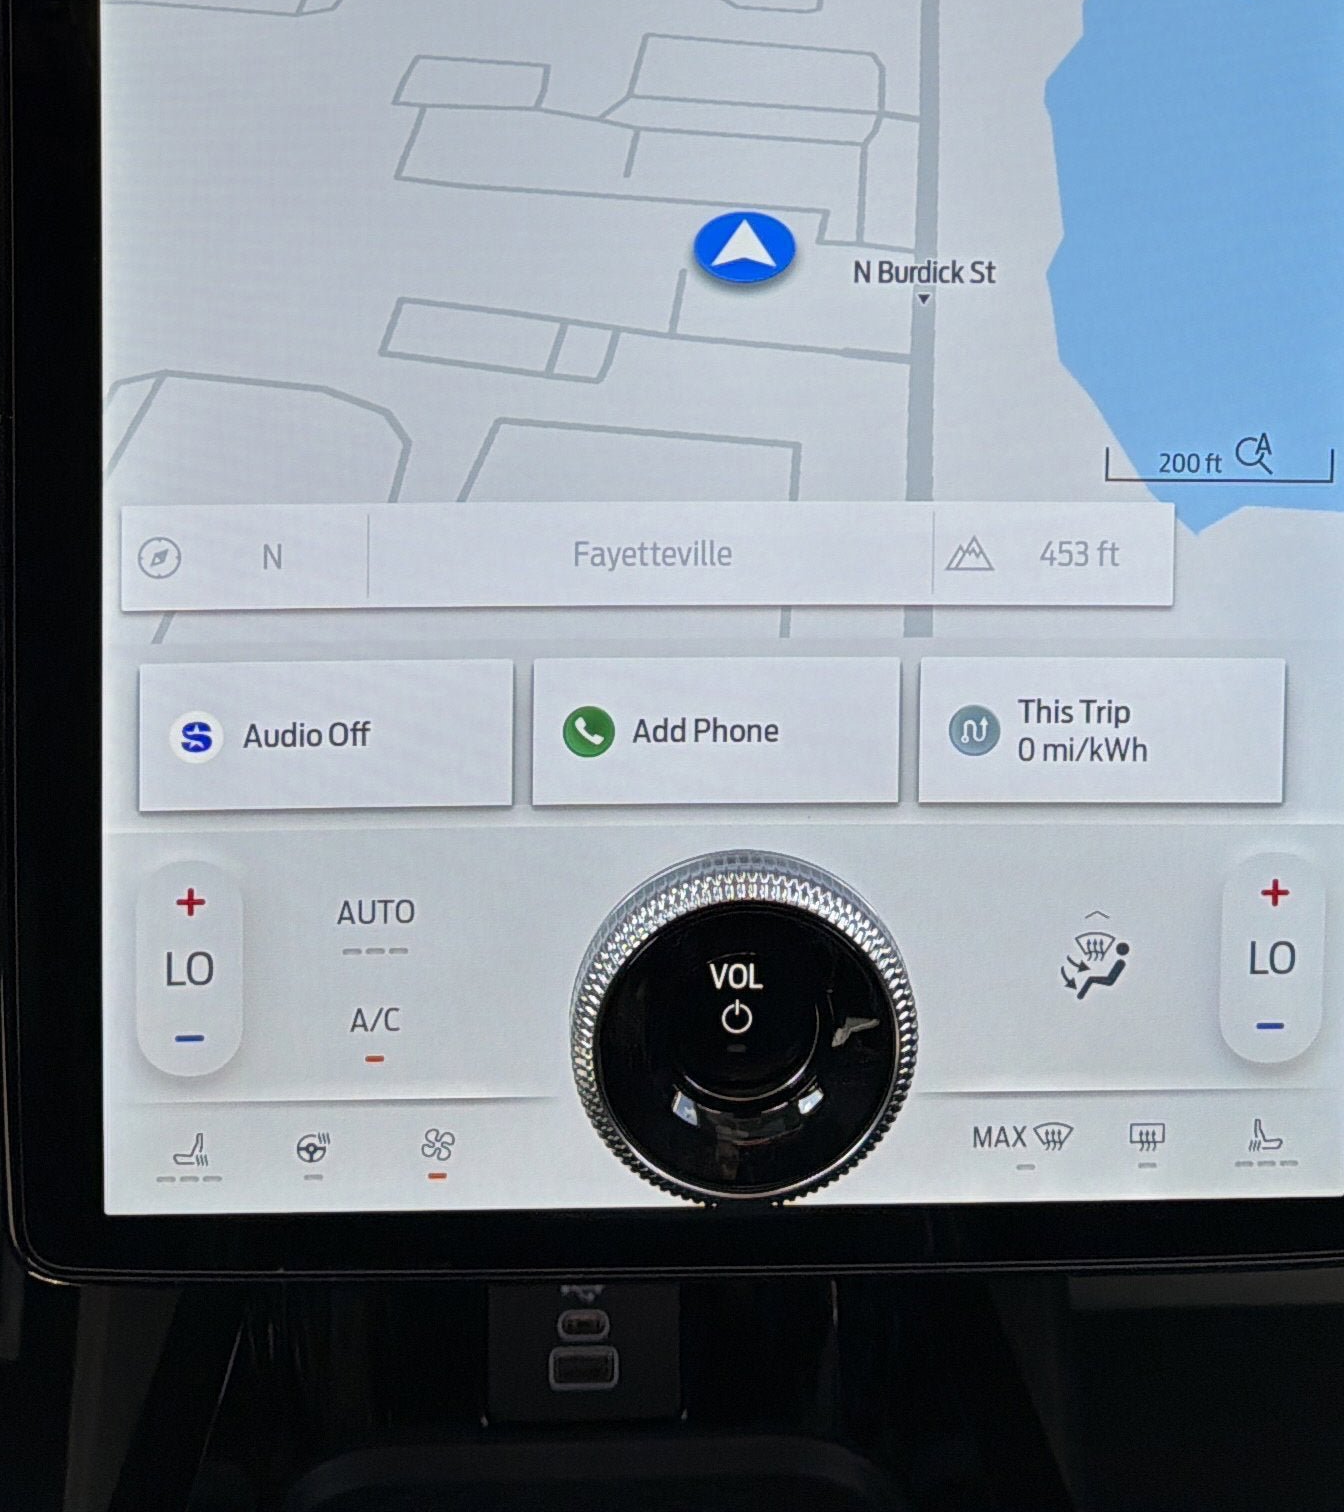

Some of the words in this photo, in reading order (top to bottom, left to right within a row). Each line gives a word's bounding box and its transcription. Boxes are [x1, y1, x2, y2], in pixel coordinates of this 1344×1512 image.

[853, 260, 871, 284] N
[878, 259, 965, 284] Burdick
[969, 260, 997, 284] St
[1158, 452, 1201, 474] 200
[1204, 452, 1223, 474] ft
[263, 543, 282, 570] N
[574, 539, 733, 572] Fayetteville
[1039, 540, 1089, 567] 453
[1096, 539, 1120, 567] ft
[1017, 697, 1074, 724] This
[1078, 699, 1131, 729] Trip
[242, 721, 323, 749] Audio
[328, 720, 371, 747] Off
[632, 716, 687, 744] Add
[693, 716, 780, 743] Phone
[1018, 736, 1035, 762] 0
[1043, 736, 1148, 762] mi/kWh
[336, 899, 415, 925] AUTO
[166, 951, 214, 987] LO
[1249, 940, 1296, 975] LO
[709, 962, 764, 990] VOL
[349, 1007, 401, 1033] A/C
[972, 1125, 1027, 1149] MAX
